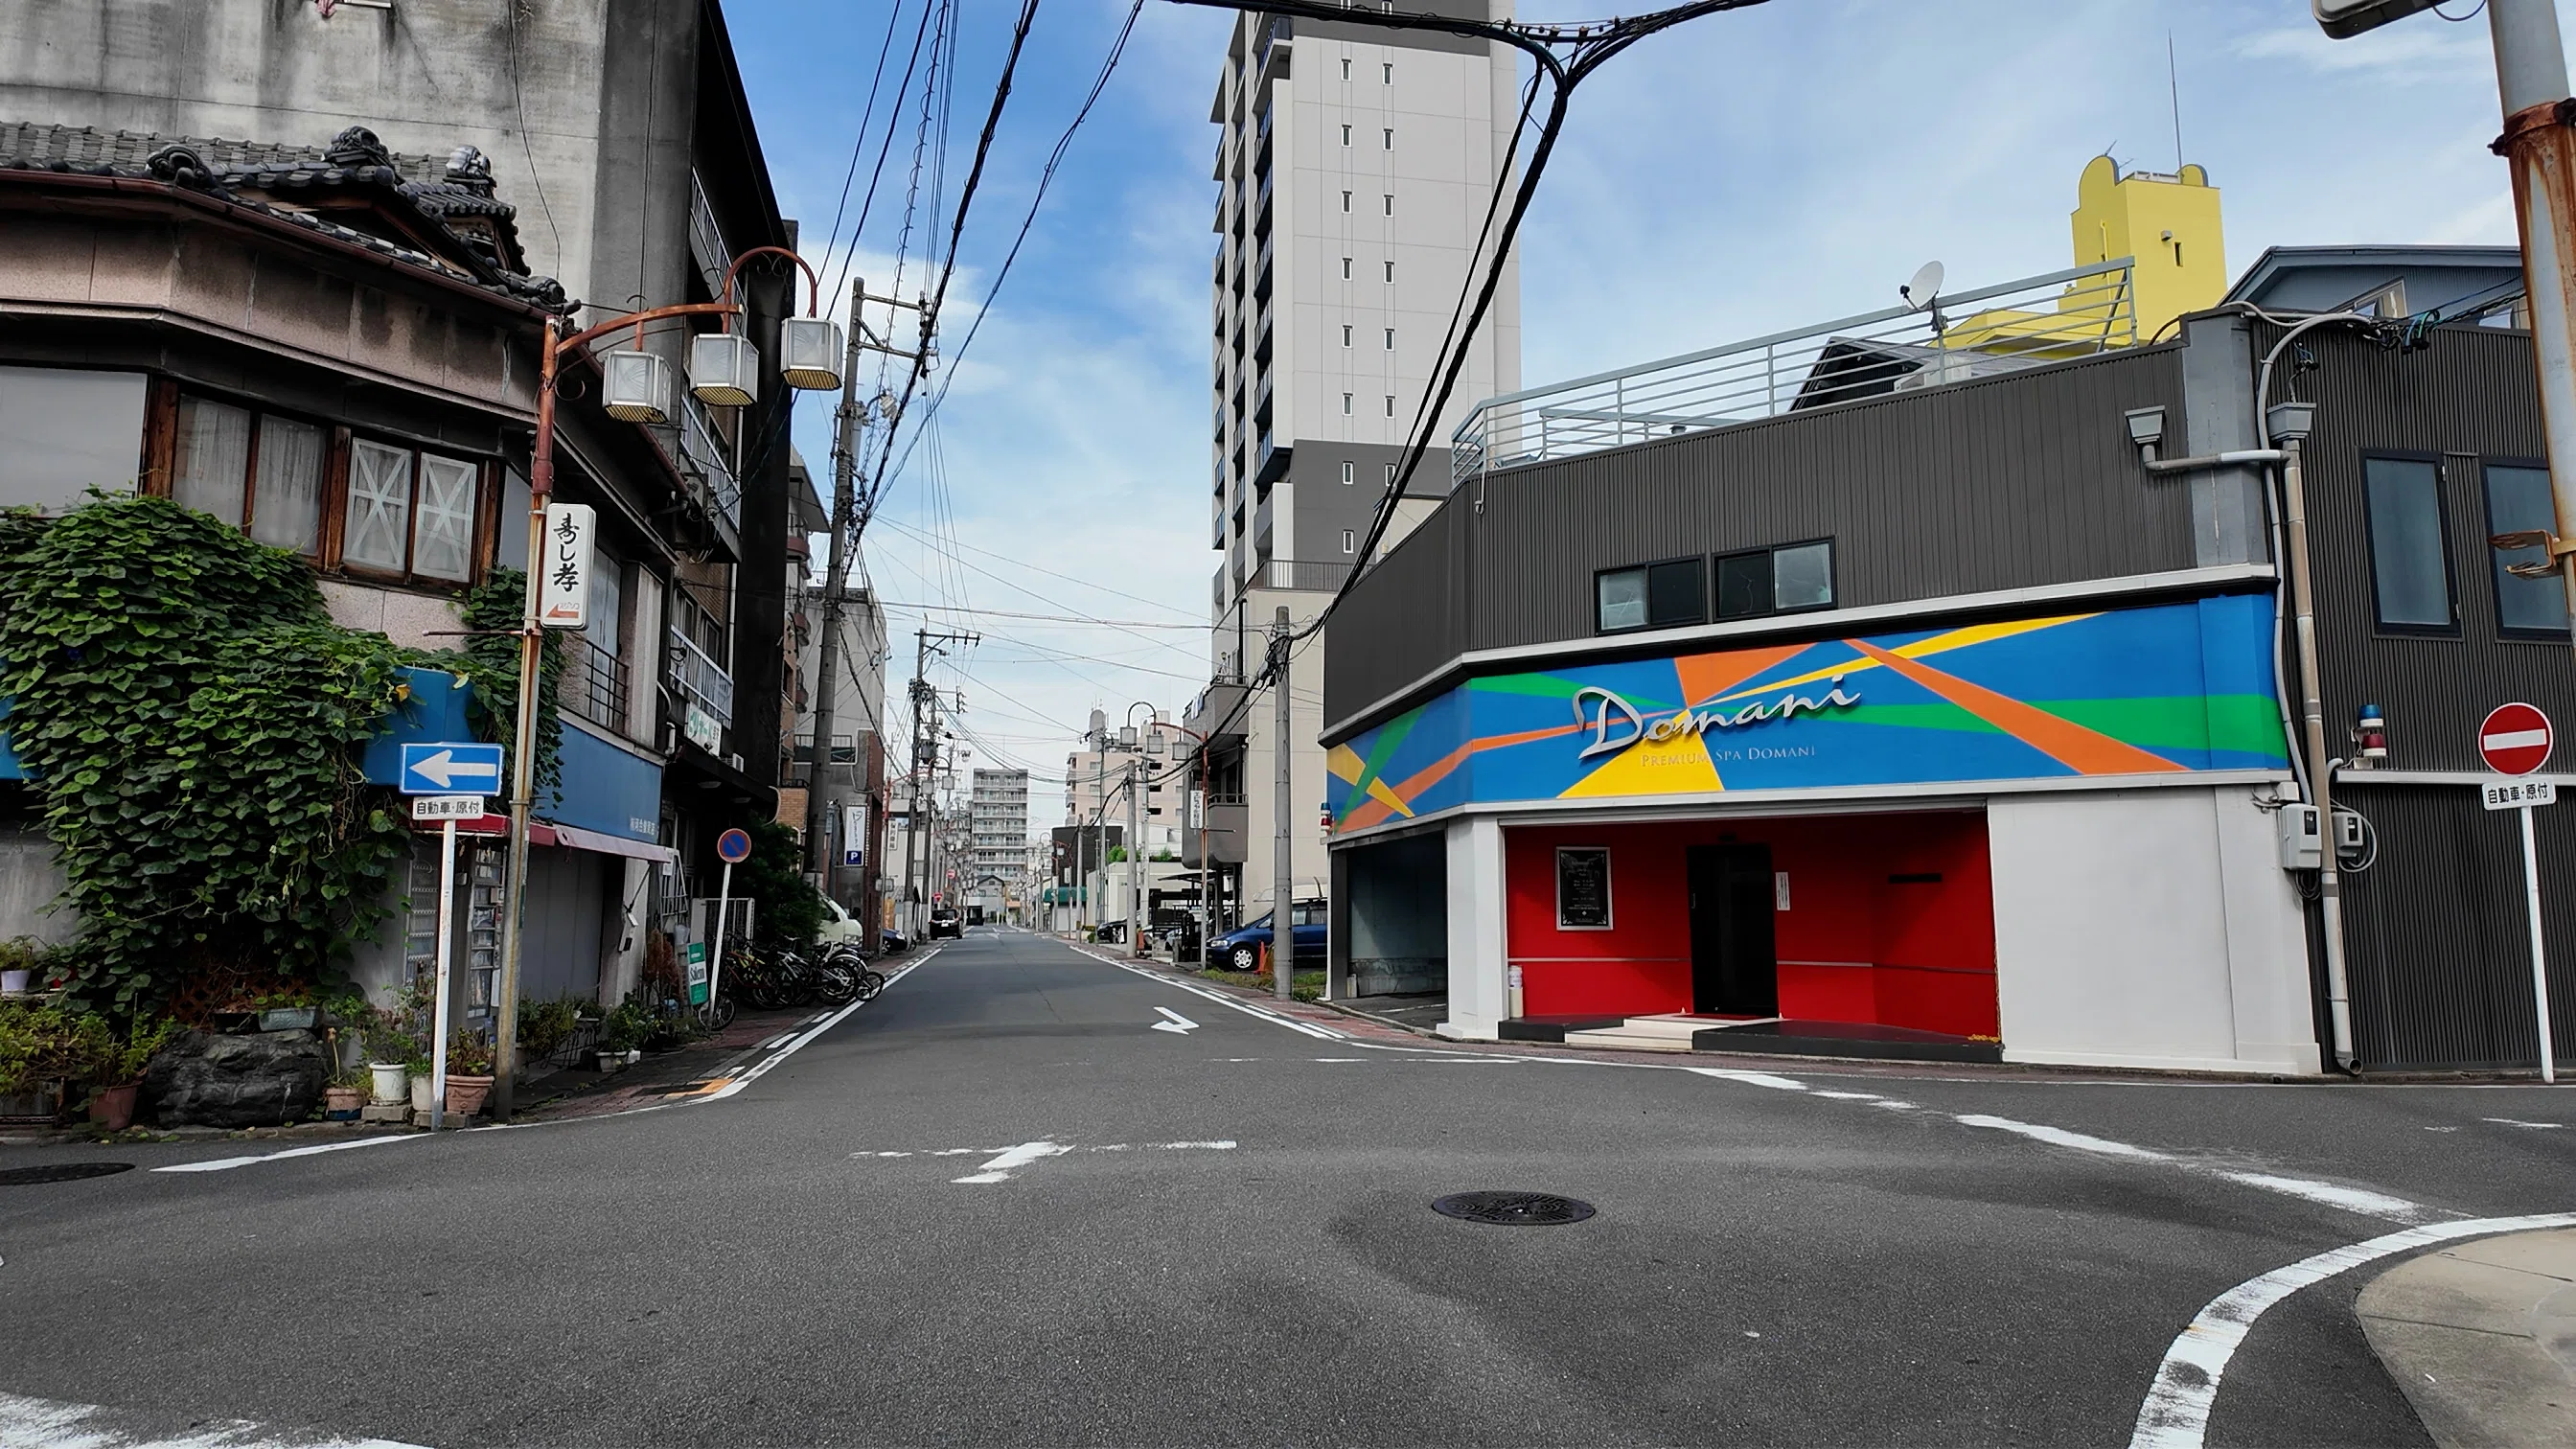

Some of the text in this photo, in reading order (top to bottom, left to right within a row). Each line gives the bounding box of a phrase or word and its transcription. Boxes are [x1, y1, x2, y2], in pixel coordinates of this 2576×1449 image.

[1572, 673, 1862, 760] Domani
[2488, 782, 2548, 804] 自動車・原付
[417, 801, 480, 815] 自動車・原付
